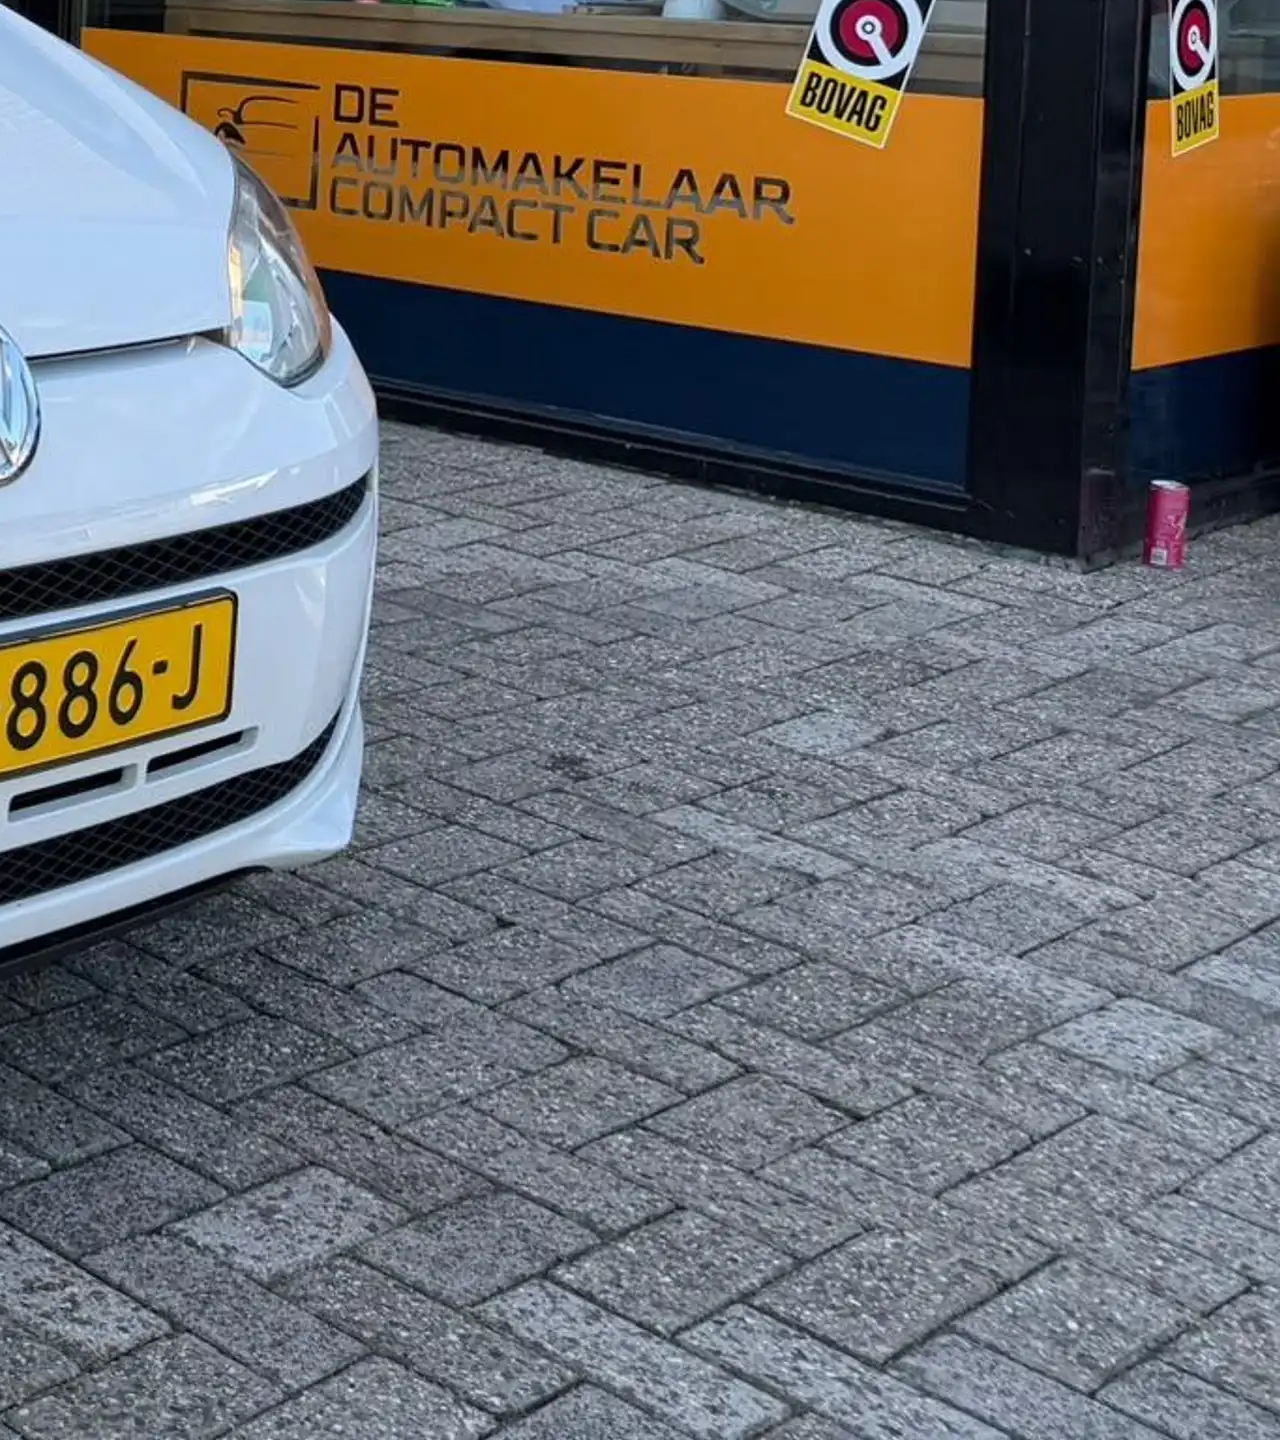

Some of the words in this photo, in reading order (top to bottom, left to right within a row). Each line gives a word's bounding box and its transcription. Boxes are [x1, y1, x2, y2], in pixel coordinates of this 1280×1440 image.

[332, 83, 400, 128] DE
[800, 71, 887, 132] BOVAG
[1177, 90, 1215, 142] BOVAG
[330, 132, 795, 225] AUTOMAKELAAR
[329, 177, 574, 245] COMPACT
[586, 208, 706, 264] CAR
